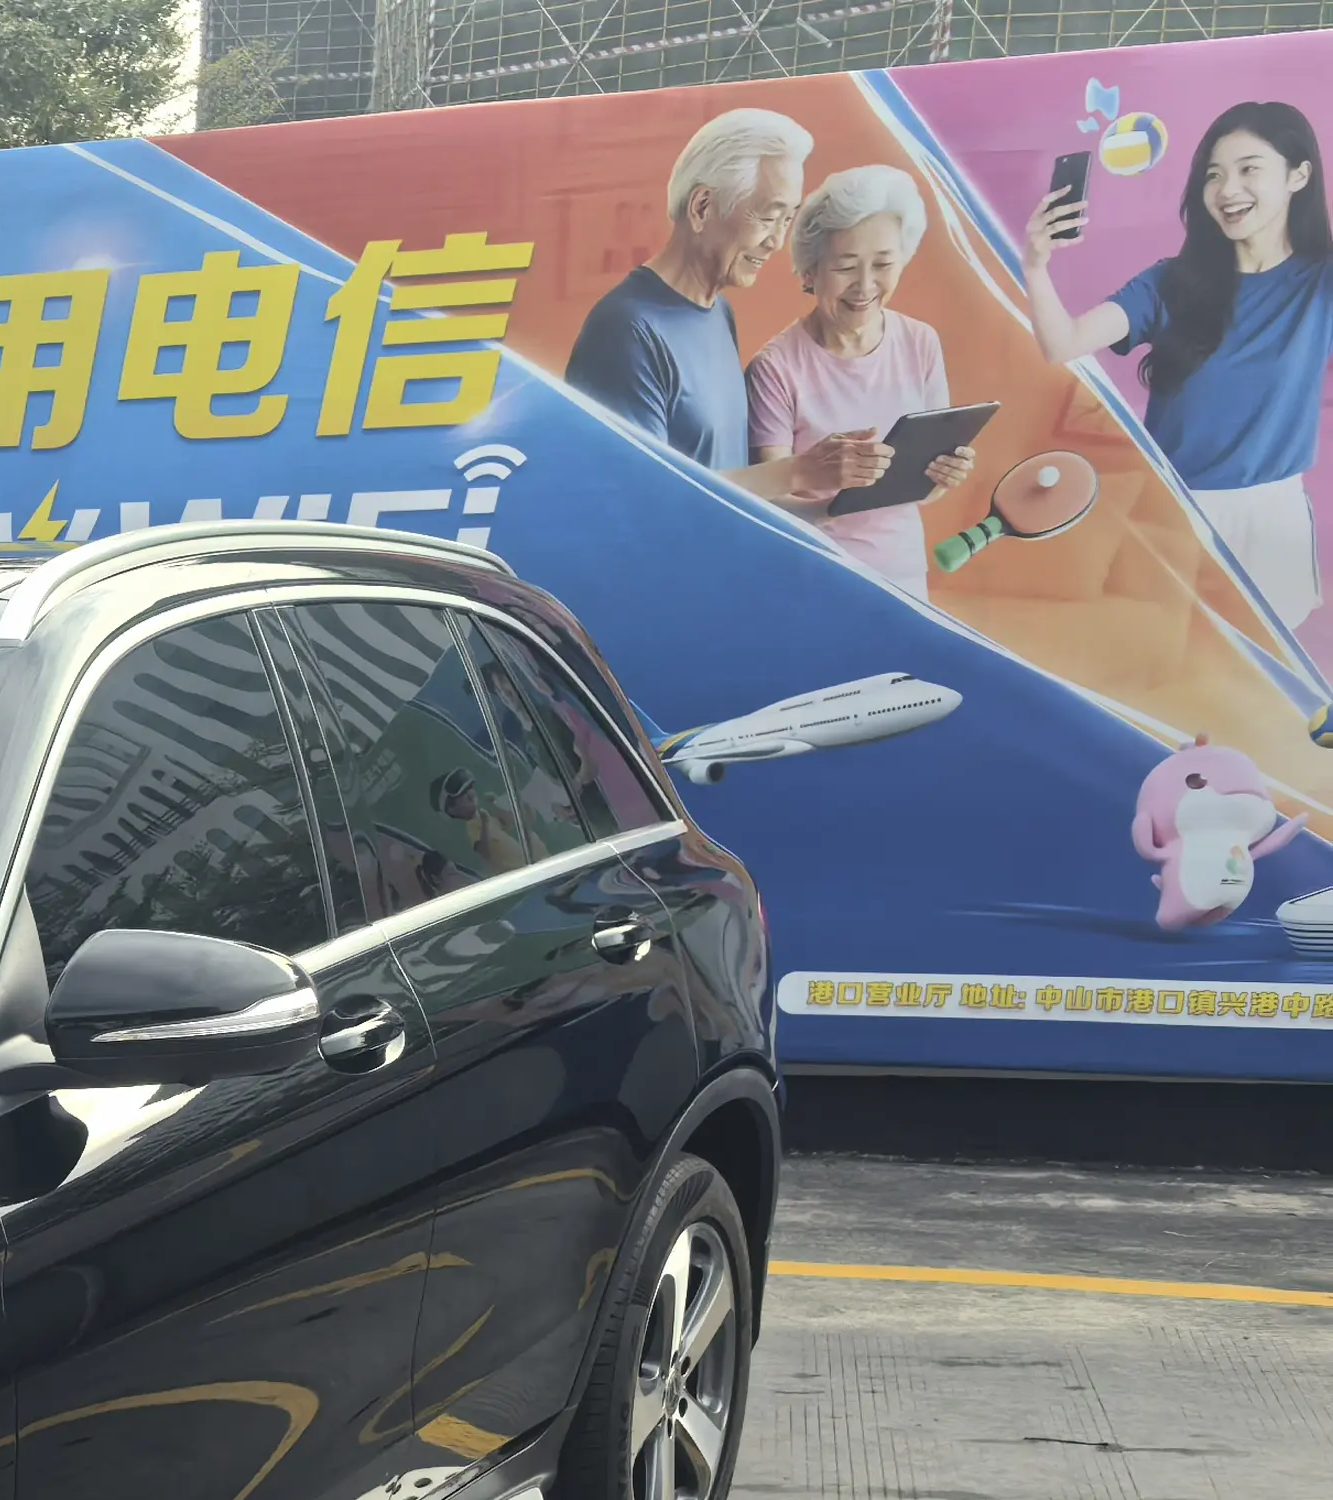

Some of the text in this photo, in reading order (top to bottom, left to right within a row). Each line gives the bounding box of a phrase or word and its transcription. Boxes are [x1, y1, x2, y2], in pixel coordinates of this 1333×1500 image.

[806, 980, 953, 1008] 港口营业厅
